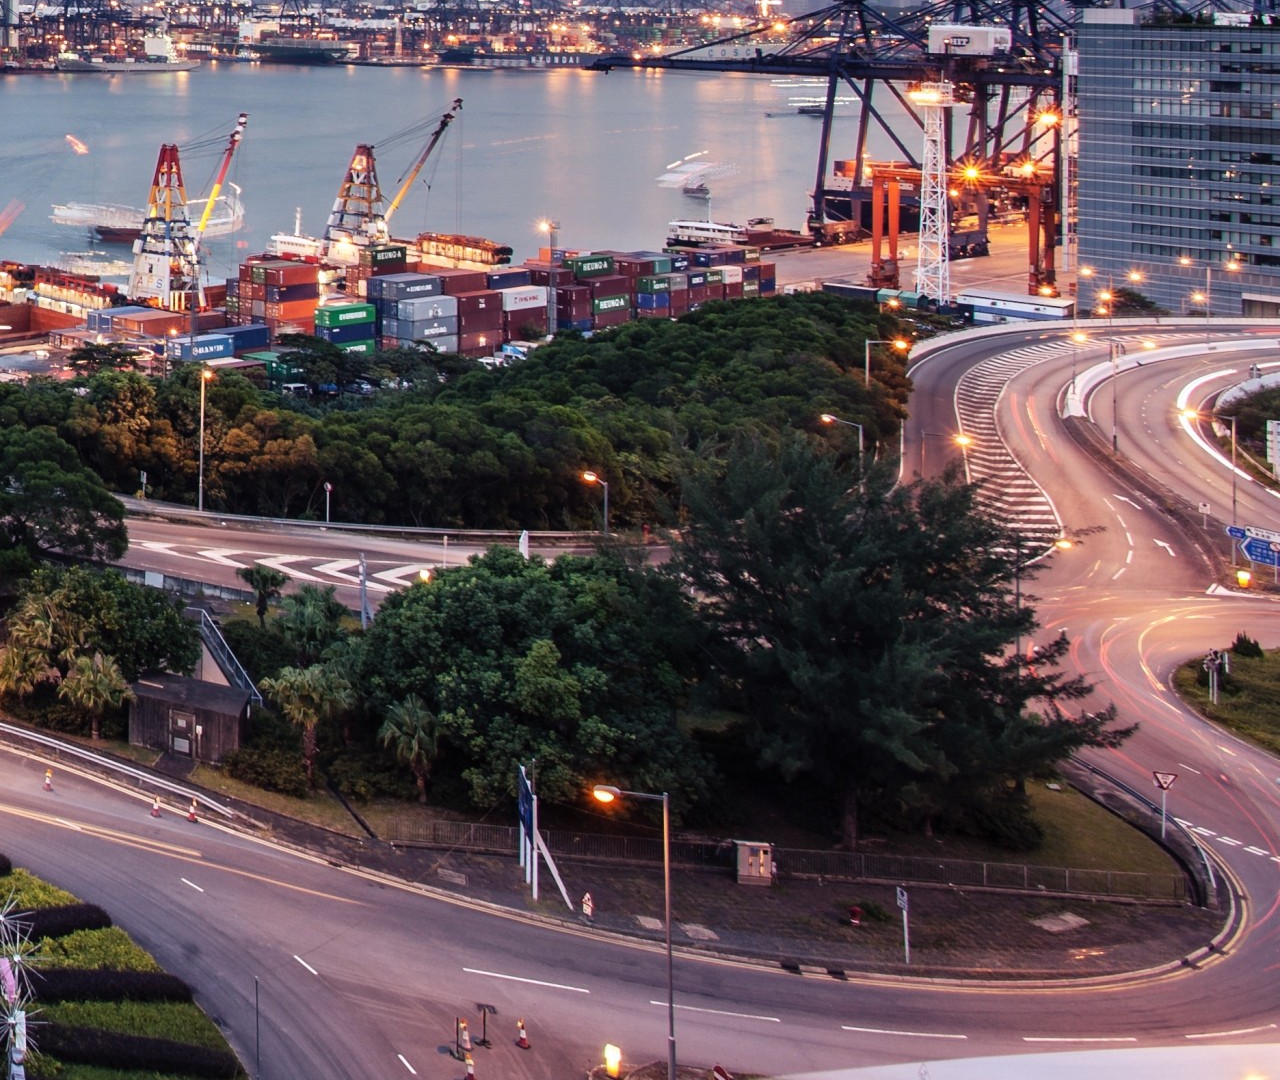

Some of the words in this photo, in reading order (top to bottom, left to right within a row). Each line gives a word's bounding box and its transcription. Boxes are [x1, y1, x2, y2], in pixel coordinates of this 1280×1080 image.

[707, 48, 752, 58] COSC
[530, 56, 580, 65] HYUNDAI
[376, 250, 402, 261] HEUNG-A
[582, 260, 608, 272] HEUNG-A
[599, 297, 625, 309] HEUNG-A
